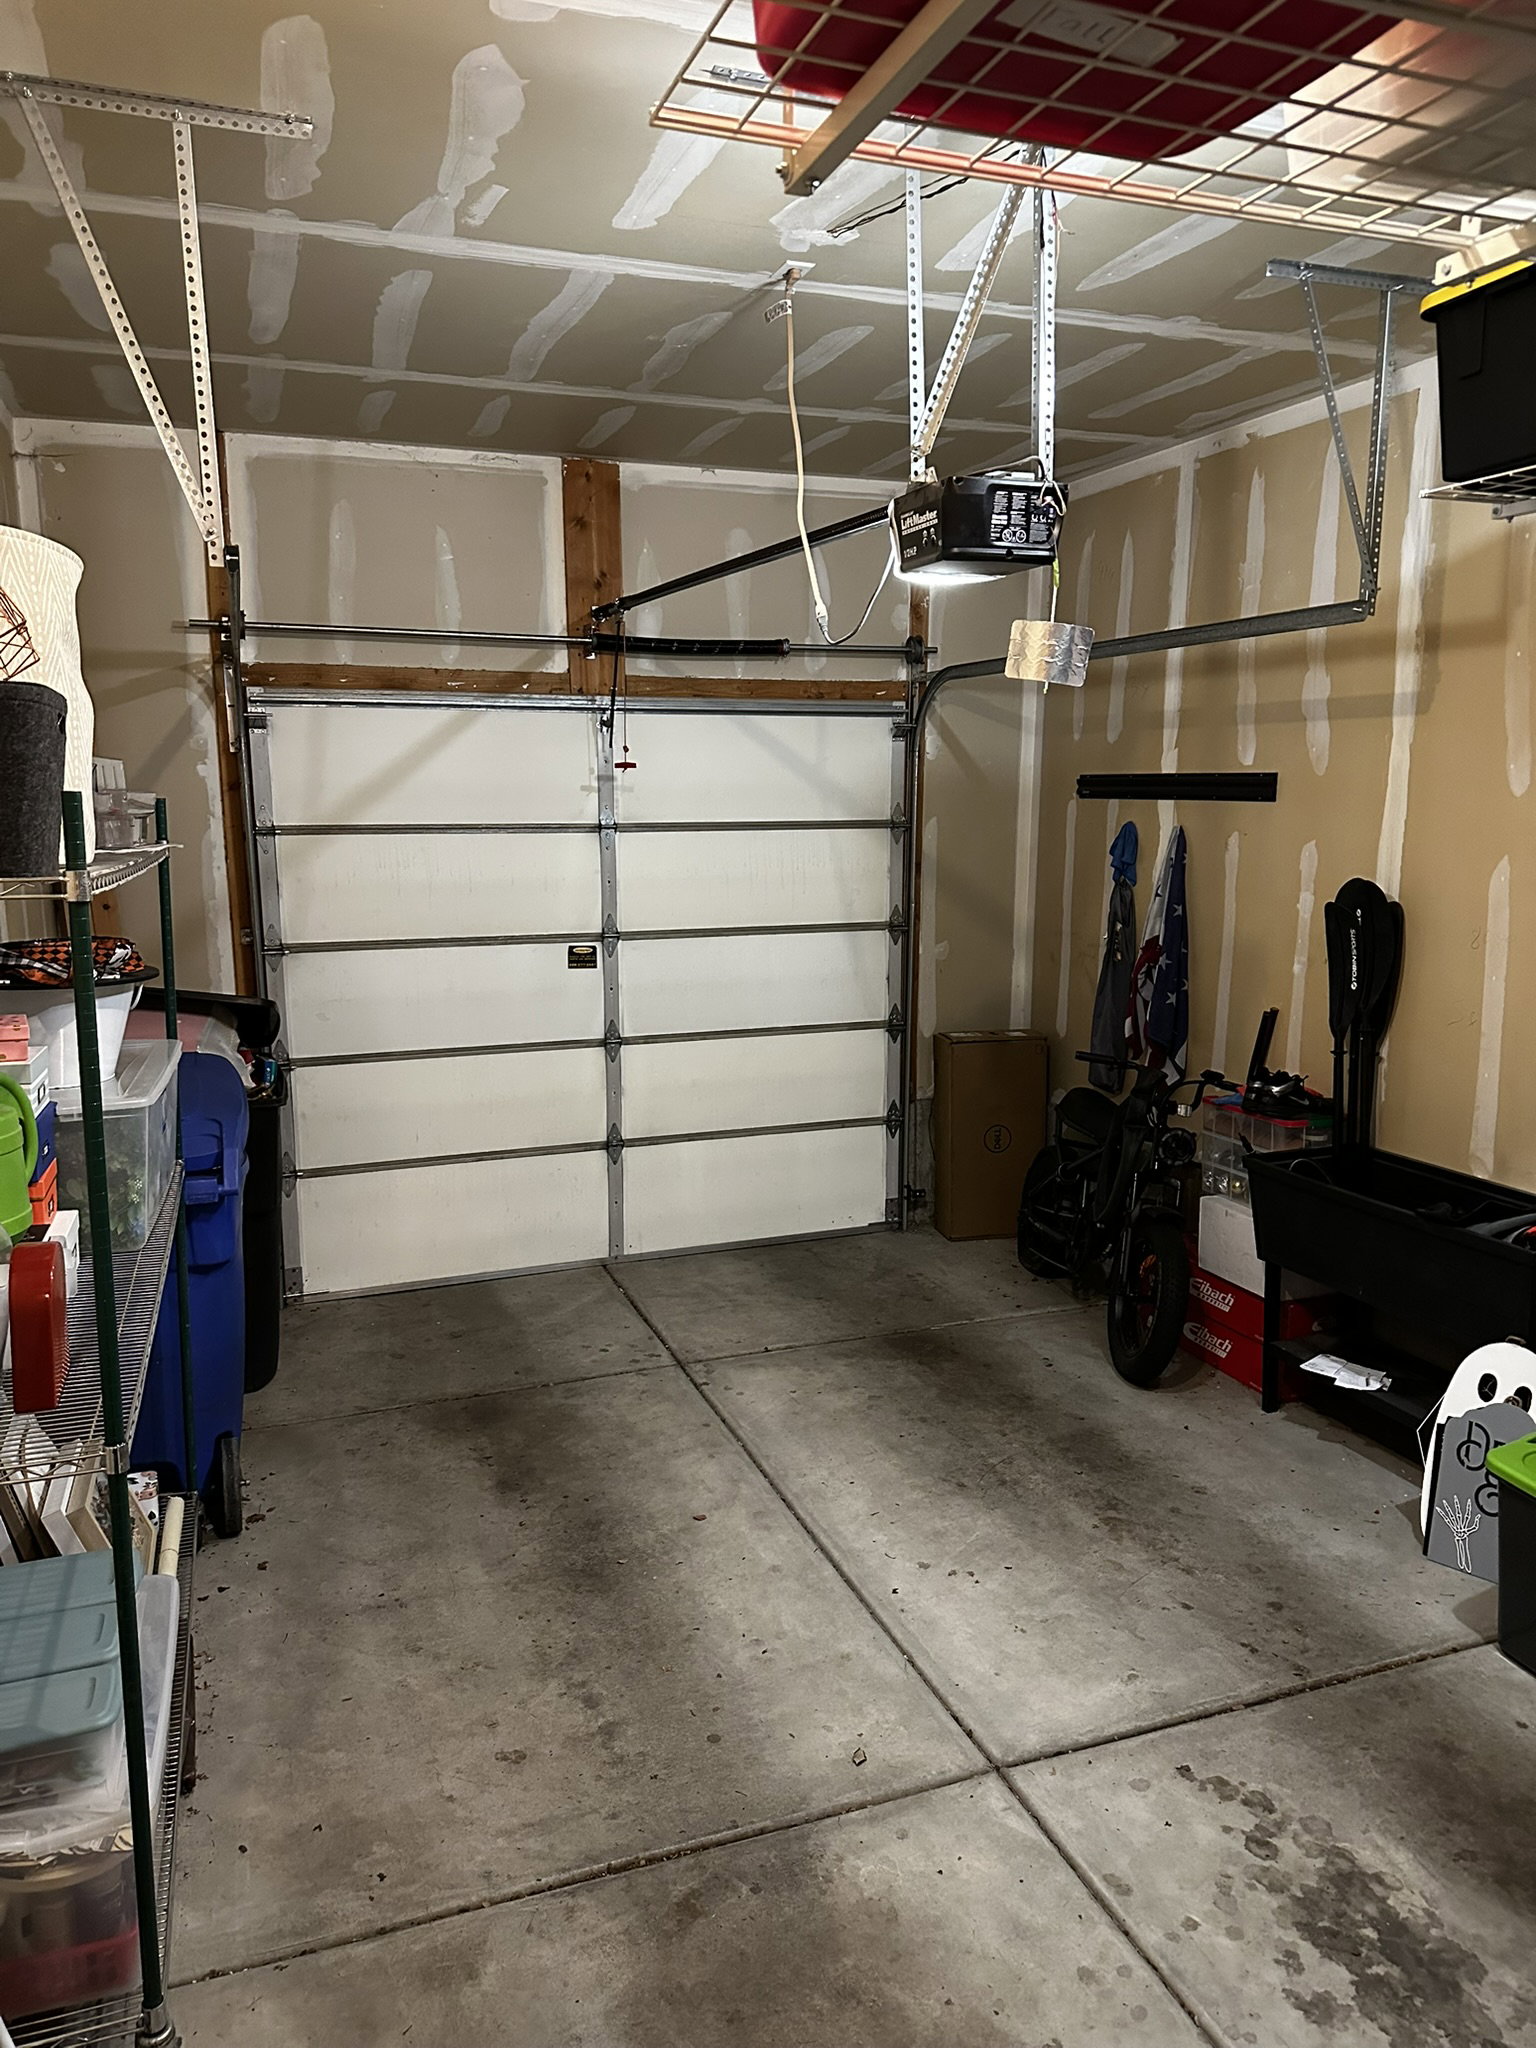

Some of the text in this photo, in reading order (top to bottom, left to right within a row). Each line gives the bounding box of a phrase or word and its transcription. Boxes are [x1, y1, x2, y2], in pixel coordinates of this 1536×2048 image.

[901, 510, 938, 530] LiftMaster
[1189, 1277, 1235, 1306] Eibach
[1183, 1321, 1233, 1353] Eibach
